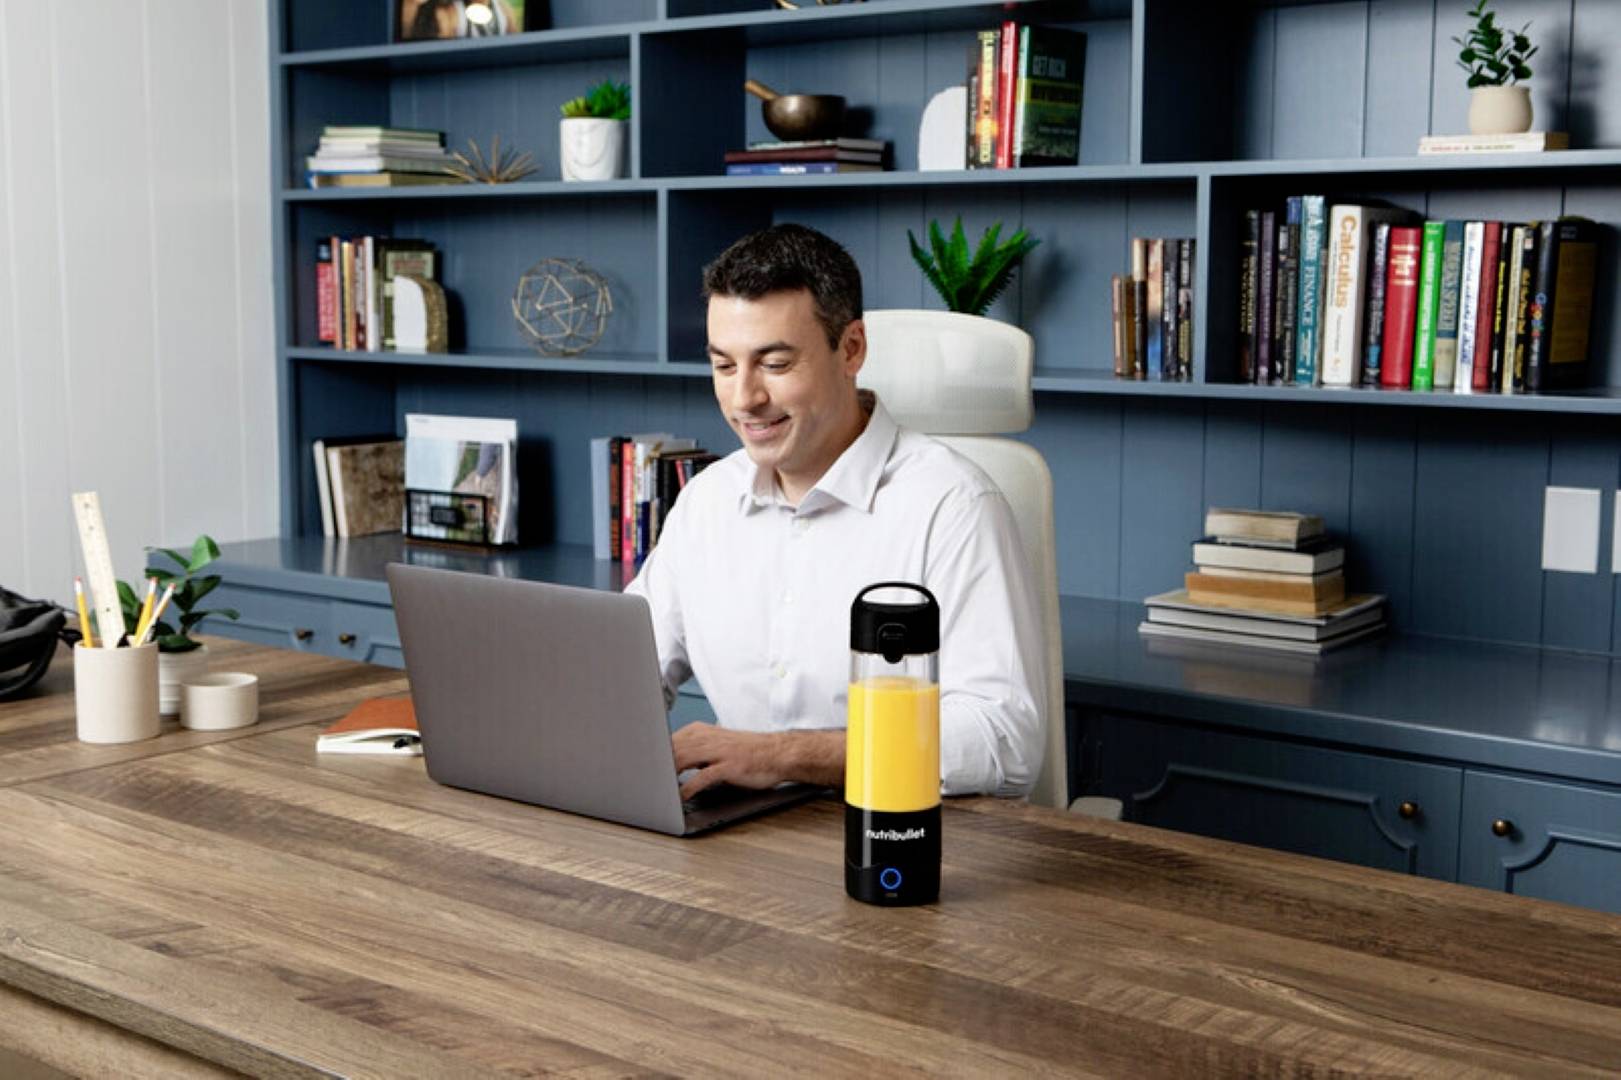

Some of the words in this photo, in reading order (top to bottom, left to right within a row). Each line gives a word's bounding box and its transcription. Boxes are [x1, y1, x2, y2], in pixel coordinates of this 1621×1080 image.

[1335, 215, 1356, 308] Calculus
[1302, 266, 1316, 326] FINANCE
[865, 827, 925, 841] nutribullet
